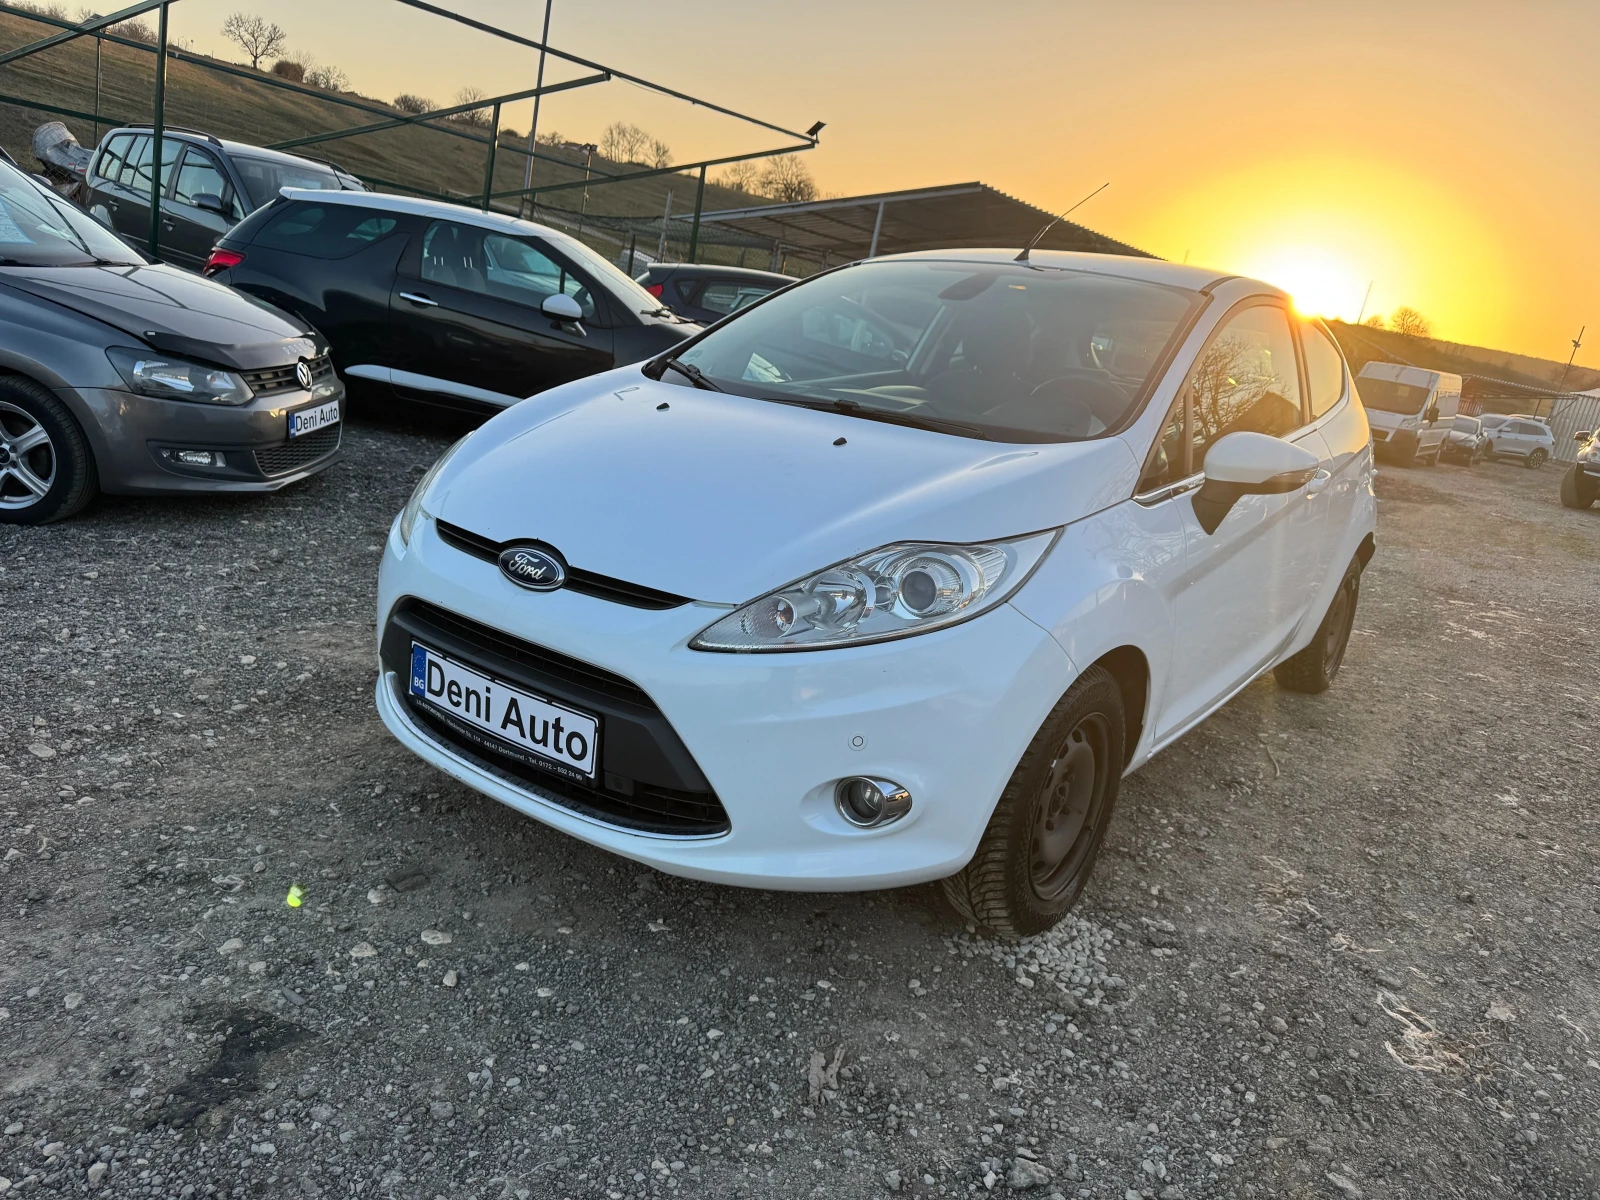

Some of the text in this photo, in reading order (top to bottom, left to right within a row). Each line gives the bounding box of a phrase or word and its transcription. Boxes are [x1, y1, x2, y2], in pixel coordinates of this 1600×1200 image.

[295, 406, 338, 432] Deni Auto
[508, 552, 547, 580] Ford
[413, 676, 425, 690] BG
[426, 658, 589, 761] Deni Auto
[498, 746, 525, 761] Dortmund
[538, 760, 552, 770] 0172
